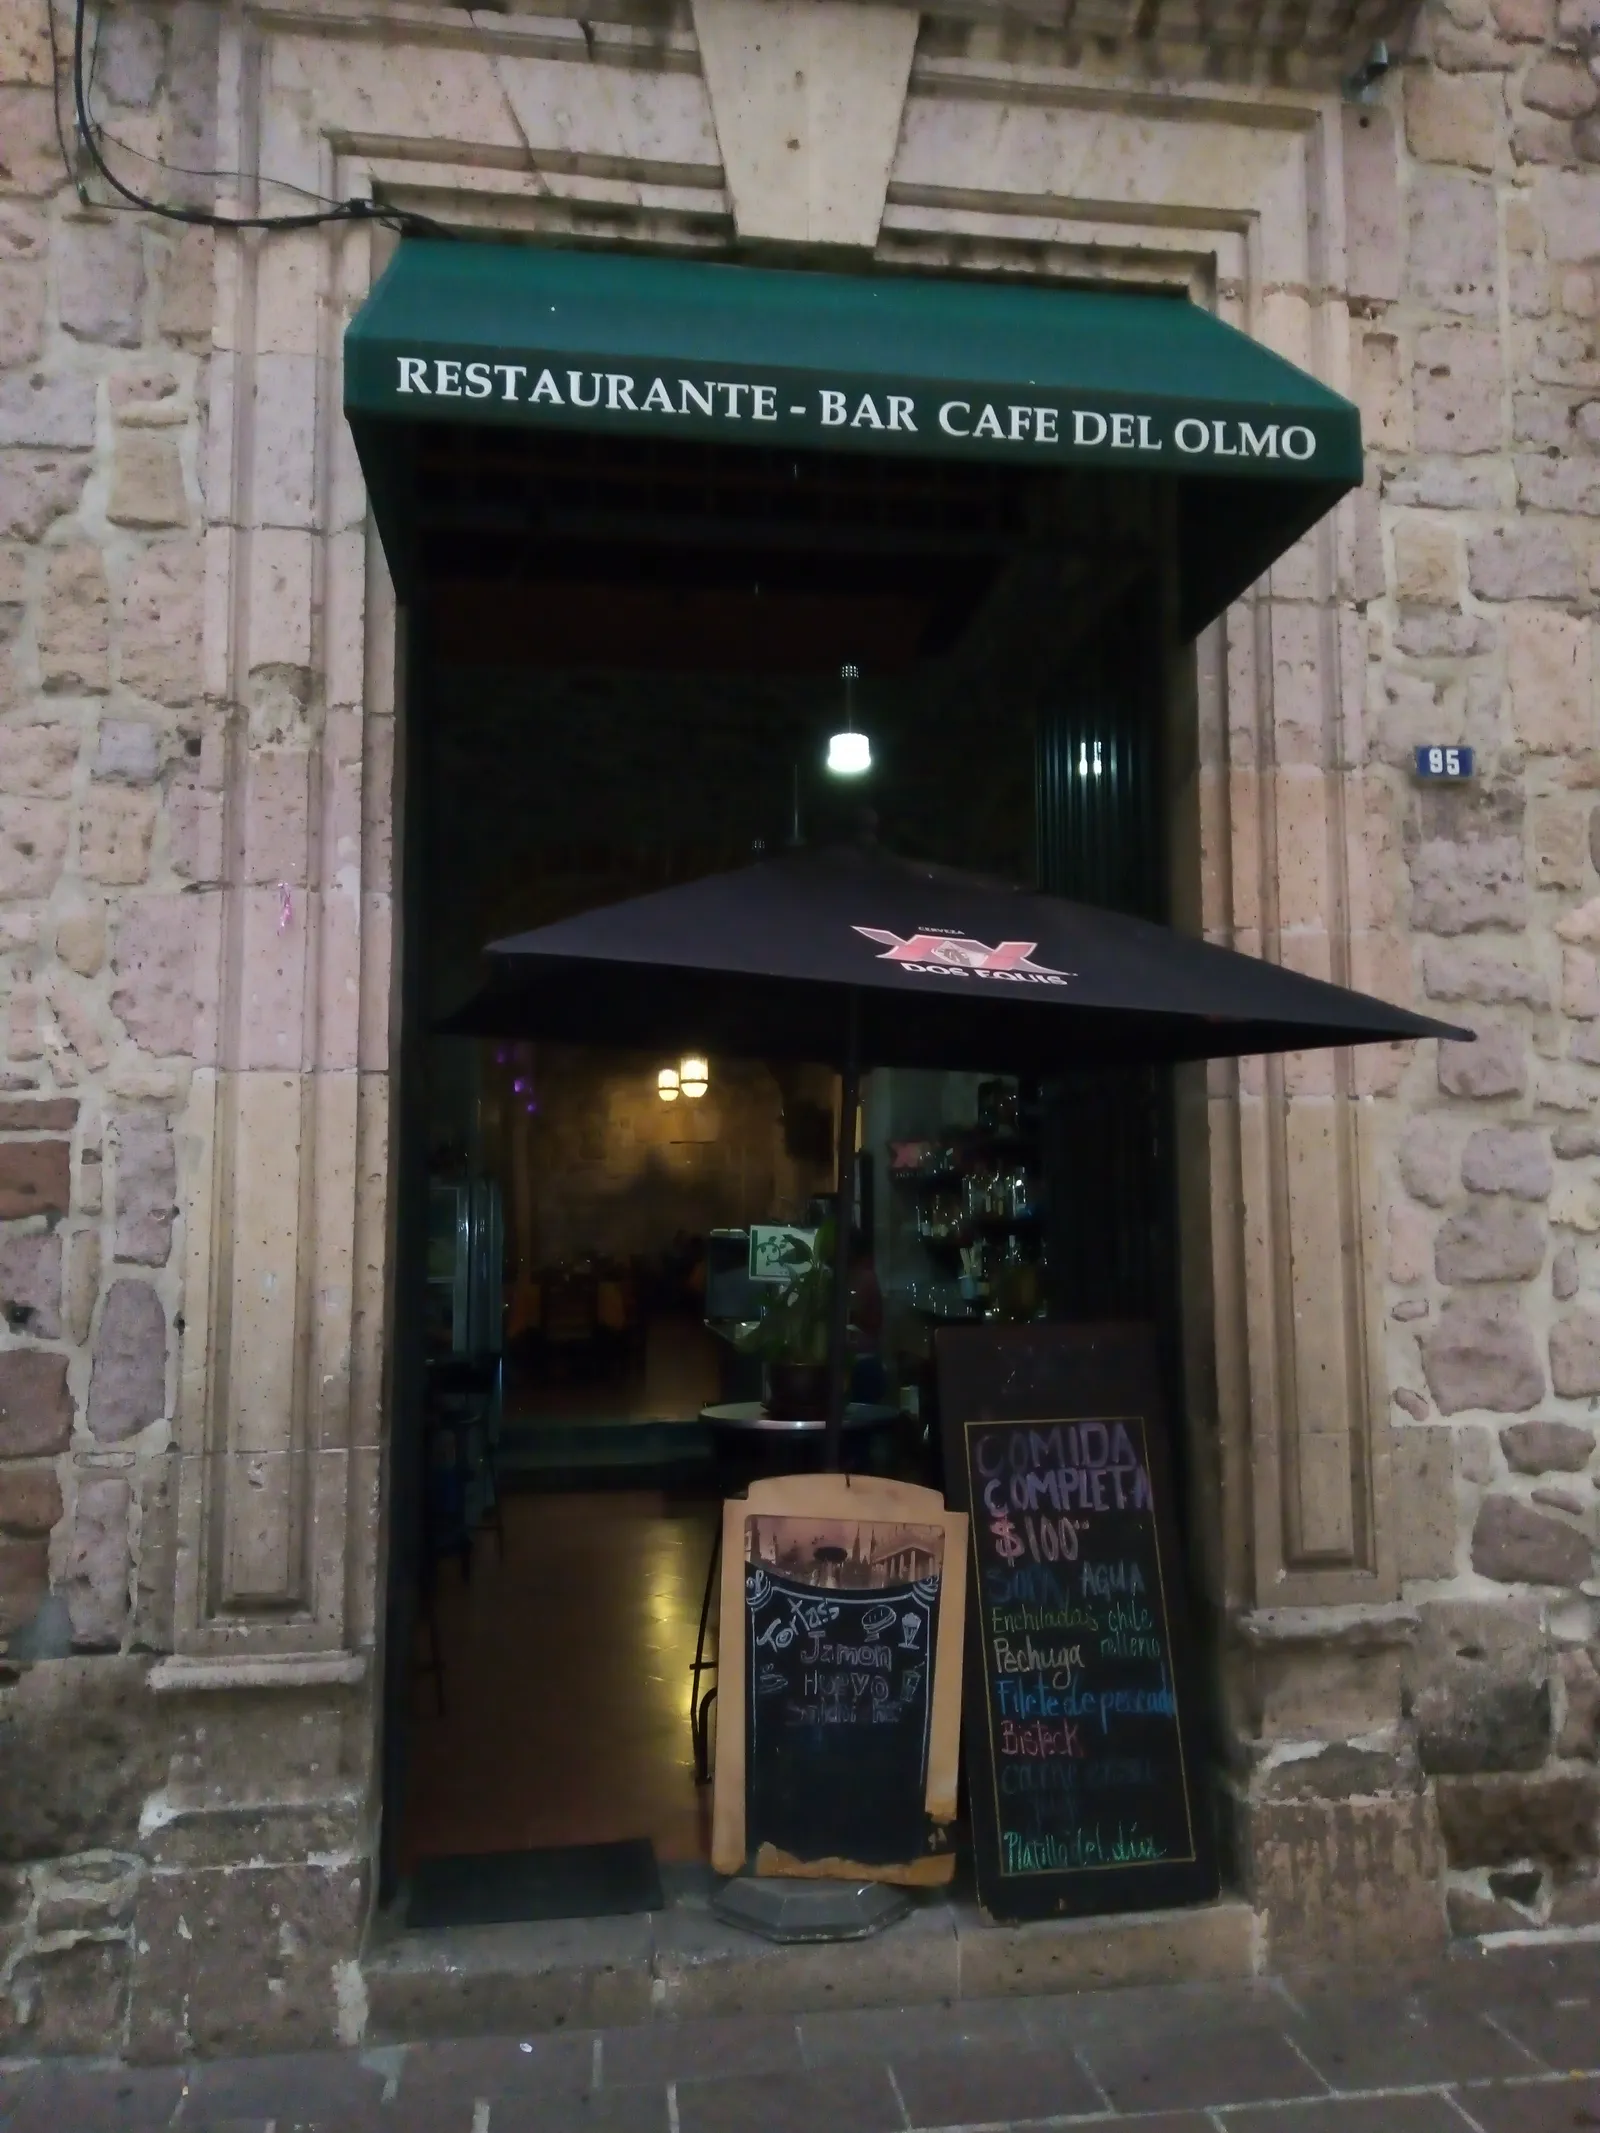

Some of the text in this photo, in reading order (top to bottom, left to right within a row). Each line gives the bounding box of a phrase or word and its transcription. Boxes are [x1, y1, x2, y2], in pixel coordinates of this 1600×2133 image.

[396, 356, 779, 421] RESTAURANTE
[818, 389, 920, 434] BAR
[937, 400, 1060, 444] CAFE
[1072, 409, 1162, 451] DEL
[1173, 417, 1317, 461] OLMO
[1428, 747, 1460, 776] 95
[899, 961, 1069, 986] DOS EQUIS
[975, 1421, 1138, 1478] COMIDA
[983, 1464, 1155, 1518] COMPLETA
[993, 1635, 1086, 1690] Pechuga
